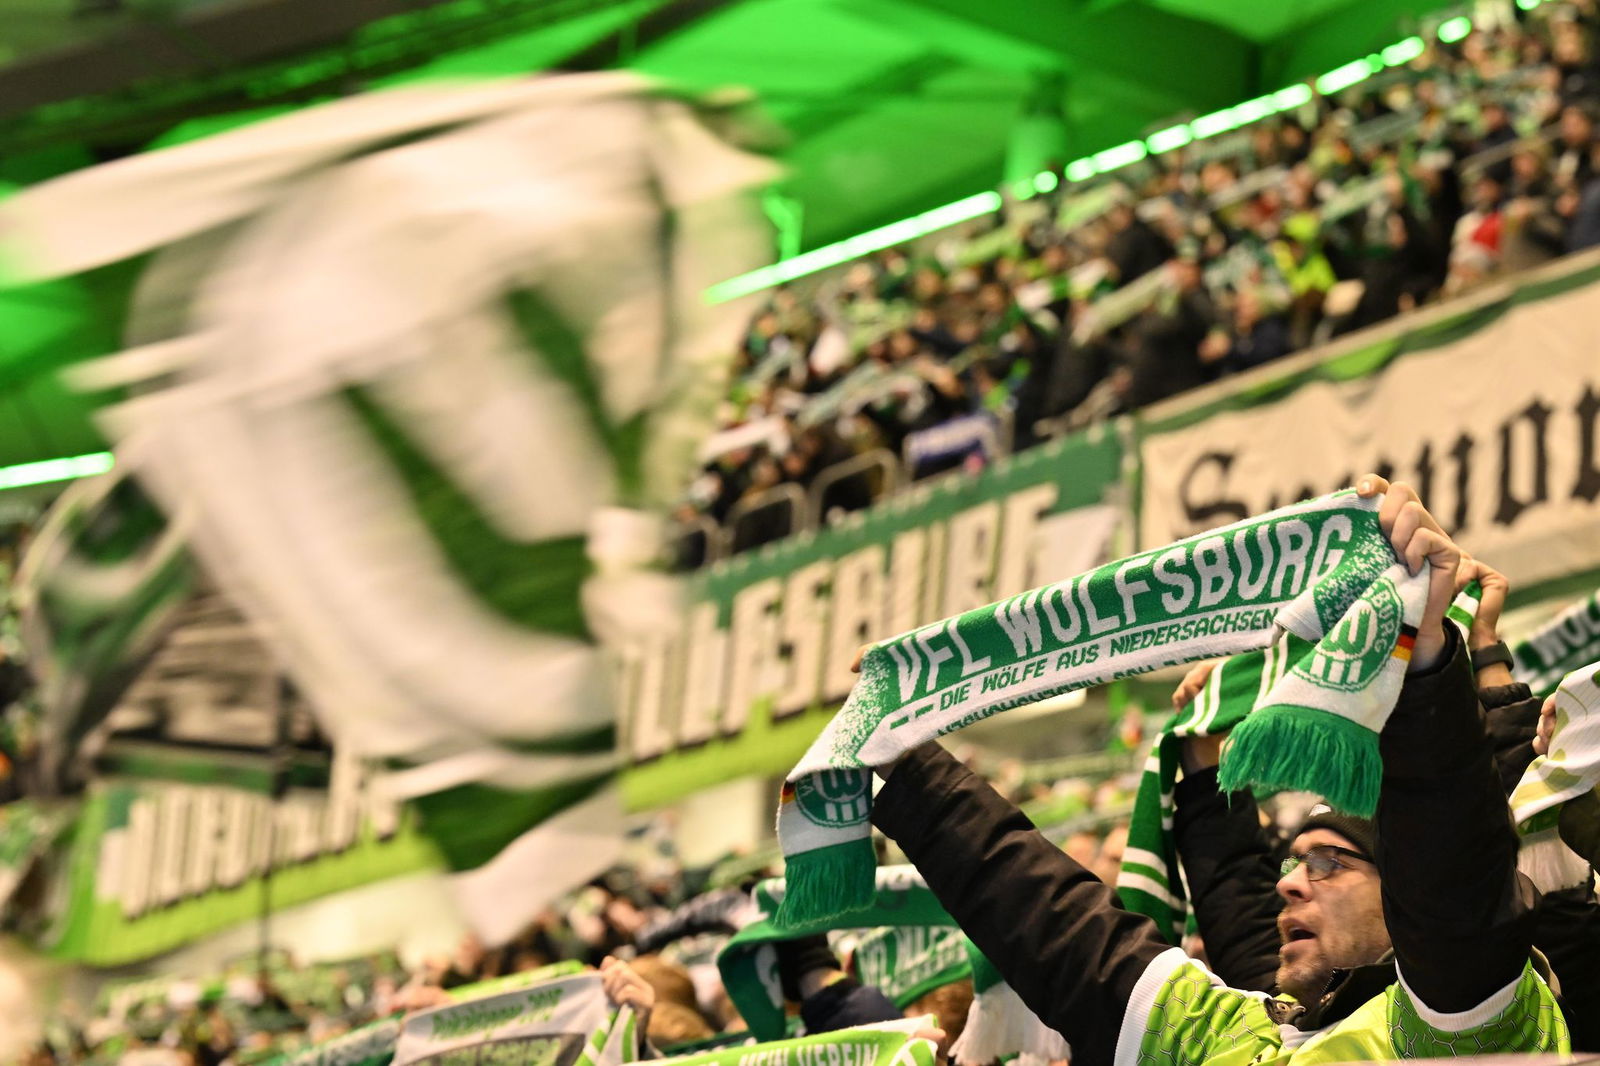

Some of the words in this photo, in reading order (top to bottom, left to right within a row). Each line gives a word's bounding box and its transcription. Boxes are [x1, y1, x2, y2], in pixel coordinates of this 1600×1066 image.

[888, 618, 992, 703] VFL
[994, 514, 1352, 659] WOLFSBURG
[940, 682, 972, 711] DIE
[980, 658, 1048, 694] WÖLFE
[1056, 643, 1099, 671] AUS
[1110, 607, 1279, 657] NIEDERSACHSEN
